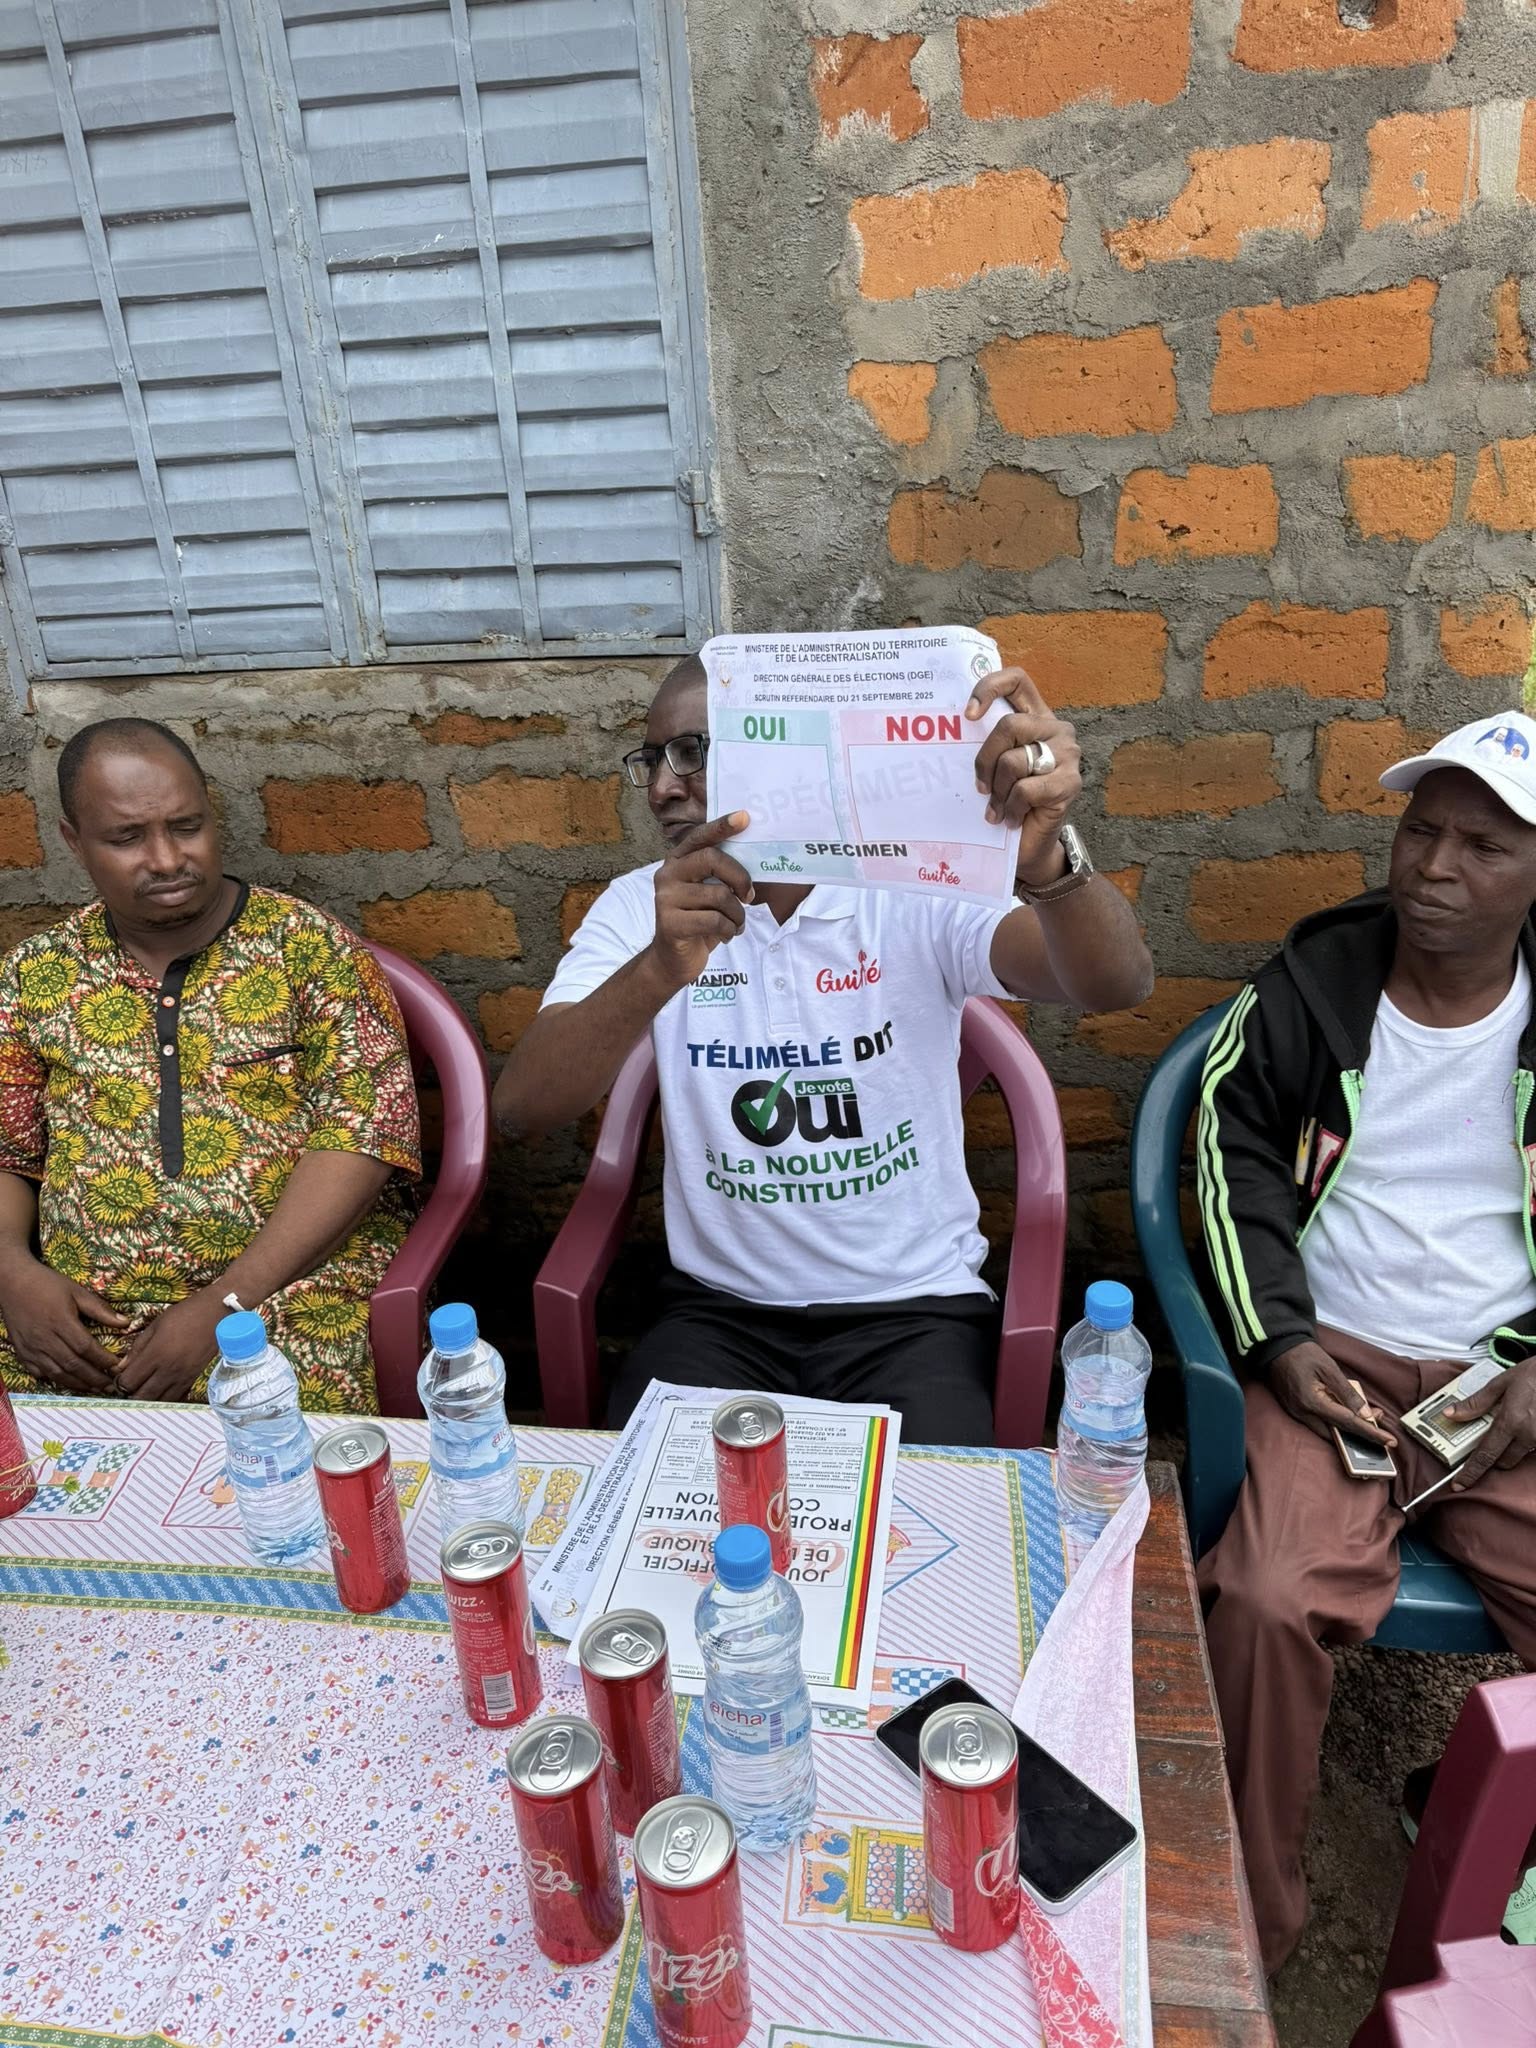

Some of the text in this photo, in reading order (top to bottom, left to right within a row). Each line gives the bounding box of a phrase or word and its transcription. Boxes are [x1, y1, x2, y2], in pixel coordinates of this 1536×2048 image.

[780, 644, 790, 653] DE
[792, 642, 870, 653] L'ADMINISTRATION
[873, 641, 886, 650] DU
[888, 638, 947, 649] TERRITOIRE
[775, 654, 784, 662] ET
[786, 654, 797, 662] DE
[798, 654, 809, 662] LA
[754, 674, 789, 683] DIRECTION
[833, 674, 851, 683] DES
[854, 671, 905, 682] ÉLECTIONS
[907, 671, 934, 681] (DGE)
[755, 694, 780, 702] SCRUTIN
[851, 694, 860, 702] 21
[862, 692, 913, 701] SEPTEMBRE
[915, 691, 934, 700] 2025
[744, 716, 785, 741] OUI
[886, 715, 961, 741] NON
[805, 842, 908, 858] SPECIMEN
[918, 861, 961, 885] Guinée
[693, 987, 736, 1002] 2040
[687, 1020, 893, 1069] TÉLIMÉLÉ DIT
[797, 1080, 851, 1094] Je vote
[721, 1152, 755, 1175] La
[766, 1119, 915, 1176] NOUVELLE
[706, 1146, 919, 1203] CONSTITUTION!
[644, 1506, 851, 1532] PROJE UVELLE
[575, 1526, 585, 1538] DE
[586, 1523, 597, 1535] DE
[585, 1536, 610, 1572] DIRECTION
[804, 1549, 829, 1562] DE
